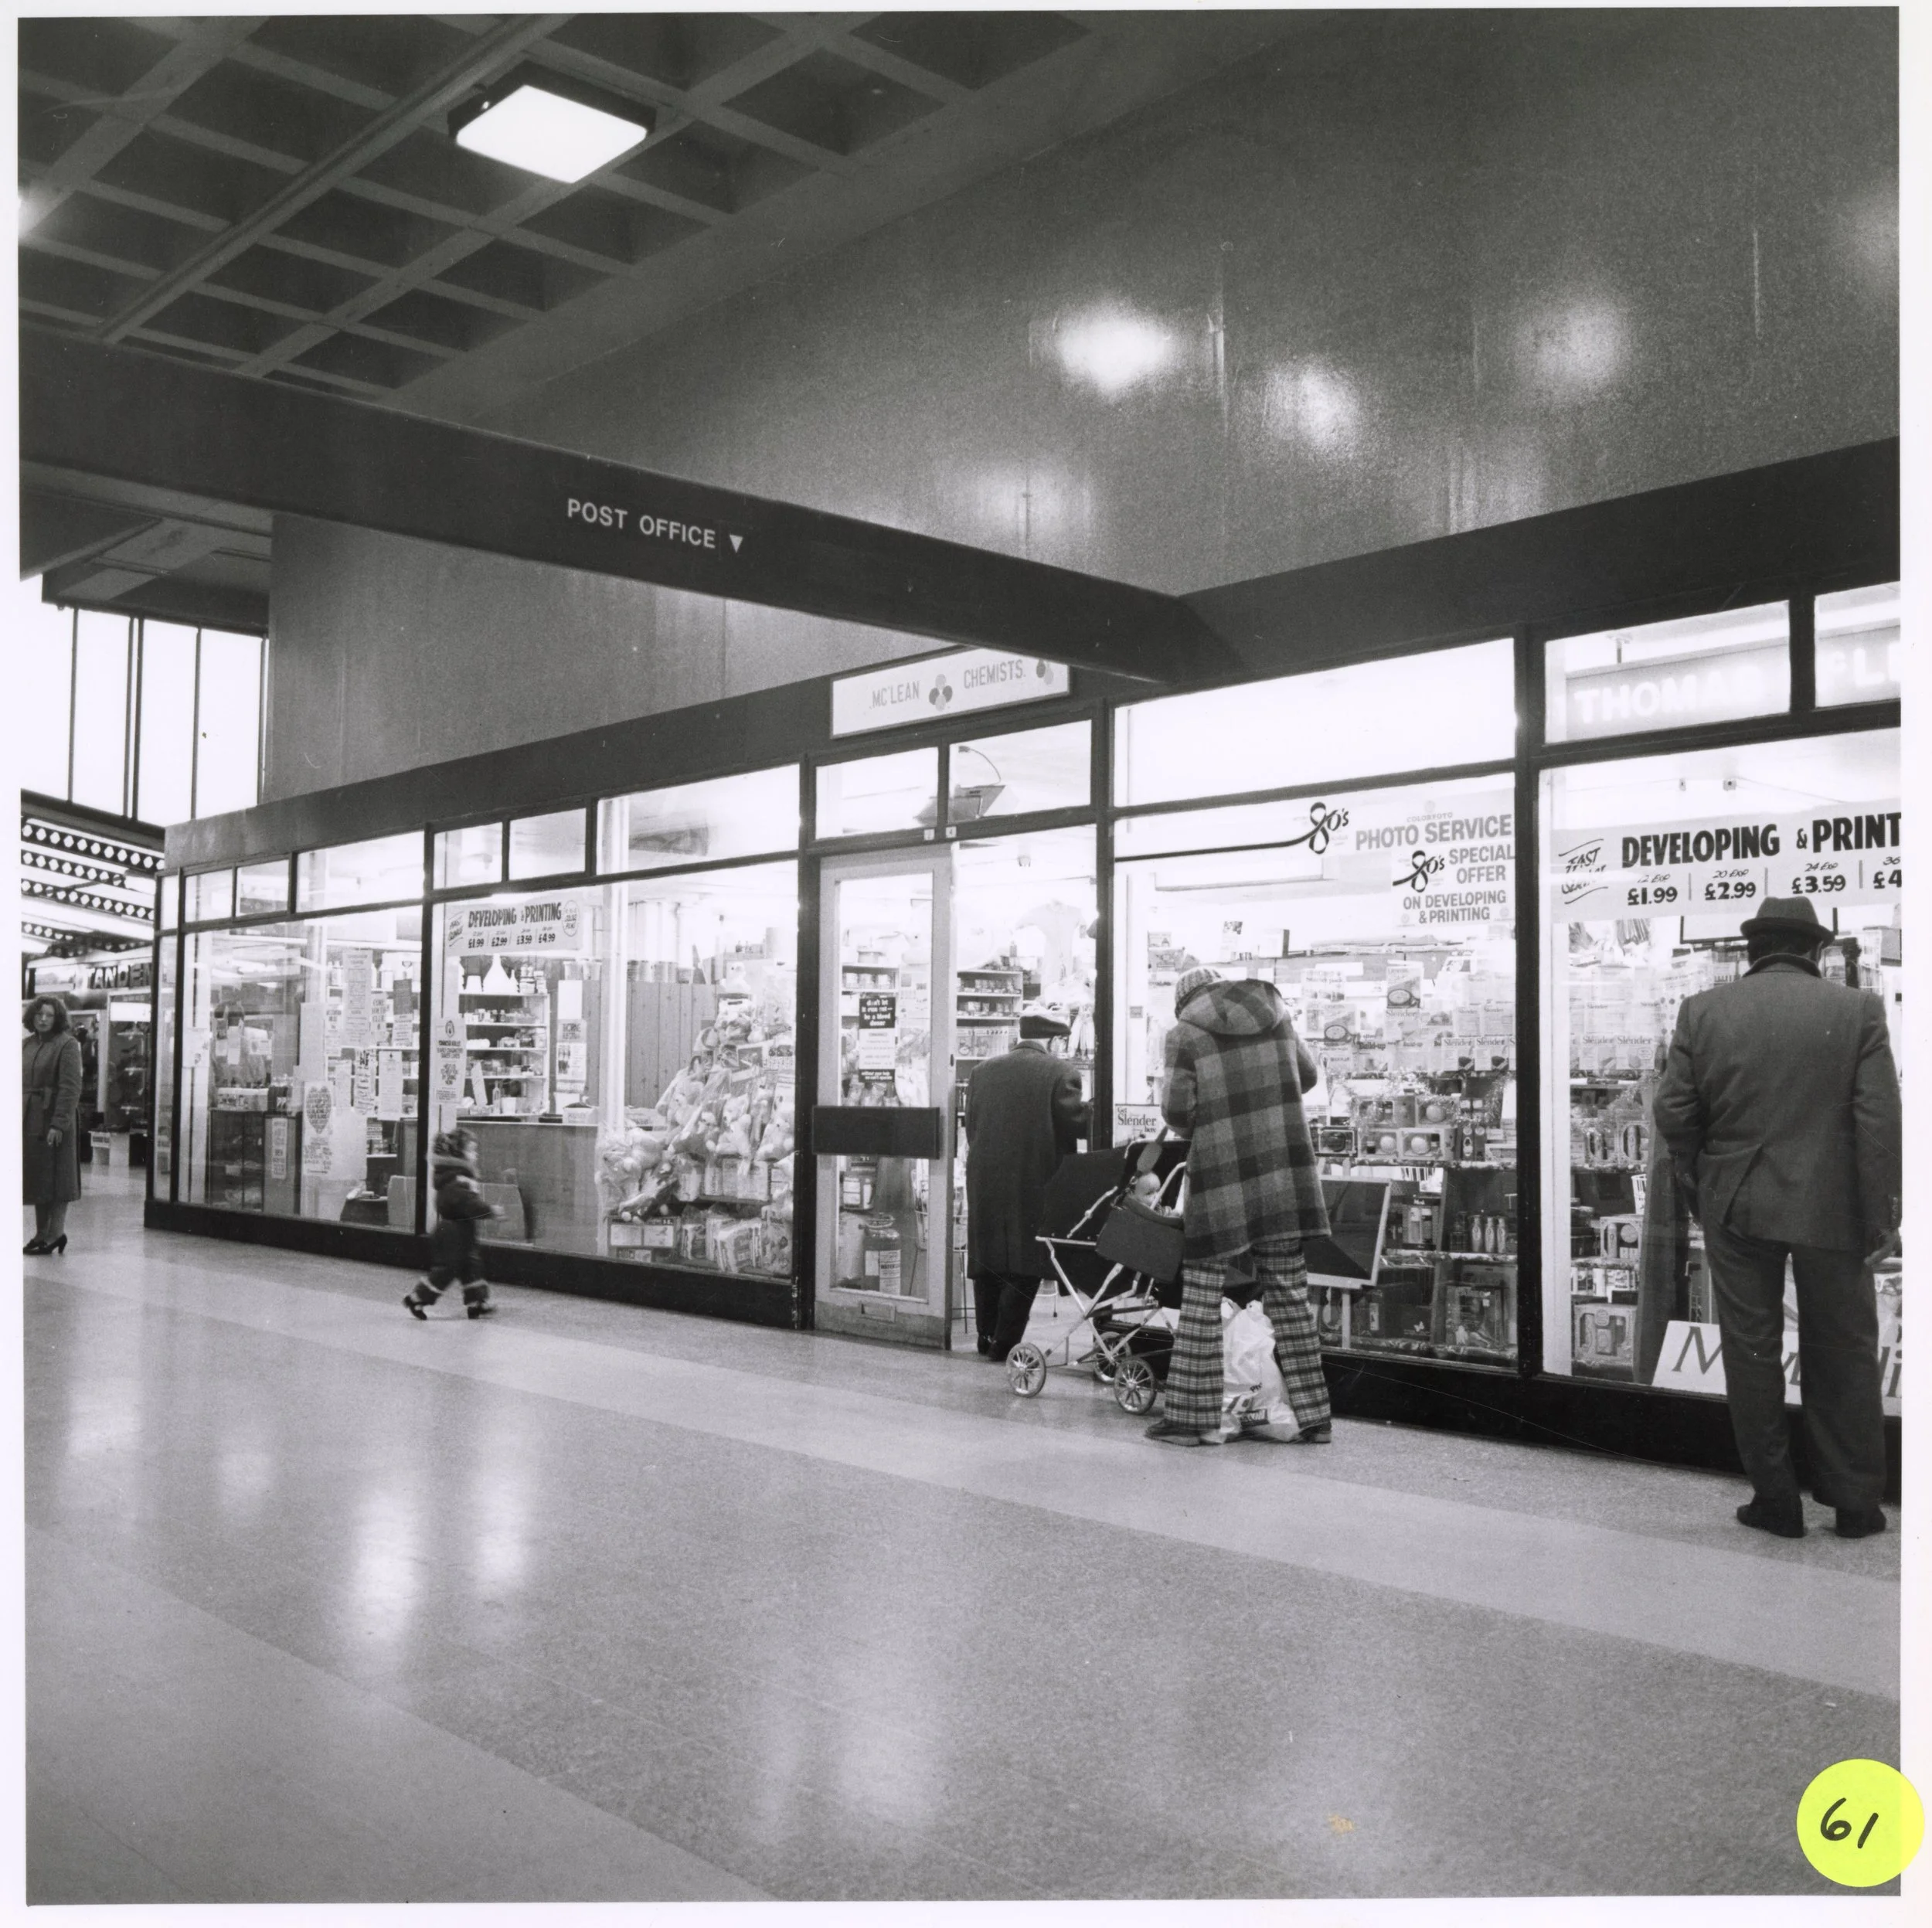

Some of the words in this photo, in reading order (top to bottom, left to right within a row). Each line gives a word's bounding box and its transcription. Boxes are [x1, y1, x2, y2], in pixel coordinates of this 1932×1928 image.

[567, 498, 628, 529] POST
[639, 515, 716, 549] OFFICE
[1573, 665, 1764, 724] THOMA
[1355, 824, 1419, 851] PHOTO
[1424, 814, 1512, 844] SERVICE
[1622, 824, 1780, 869] DEVELOPING
[1796, 828, 1808, 849] &
[1812, 812, 1901, 853] PRINT
[1448, 844, 1515, 865] SPECIAL
[1457, 865, 1506, 884] OFFER
[1804, 862, 1819, 872] 24
[1705, 882, 1756, 901] £2.99
[1791, 874, 1845, 894] £3.59
[1403, 896, 1420, 910] ON
[1425, 889, 1506, 909] DEVELOPING
[1628, 886, 1678, 906] £1.99
[468, 907, 517, 928] DEVELOPING
[525, 902, 562, 923] PRINTING
[1429, 906, 1490, 923] PRINTING
[1444, 1038, 1472, 1046] Slender
[1476, 1037, 1505, 1046] Slender
[1582, 1035, 1614, 1045] Slender
[1617, 1035, 1653, 1045] Slender
[1117, 1113, 1157, 1126] Slender
